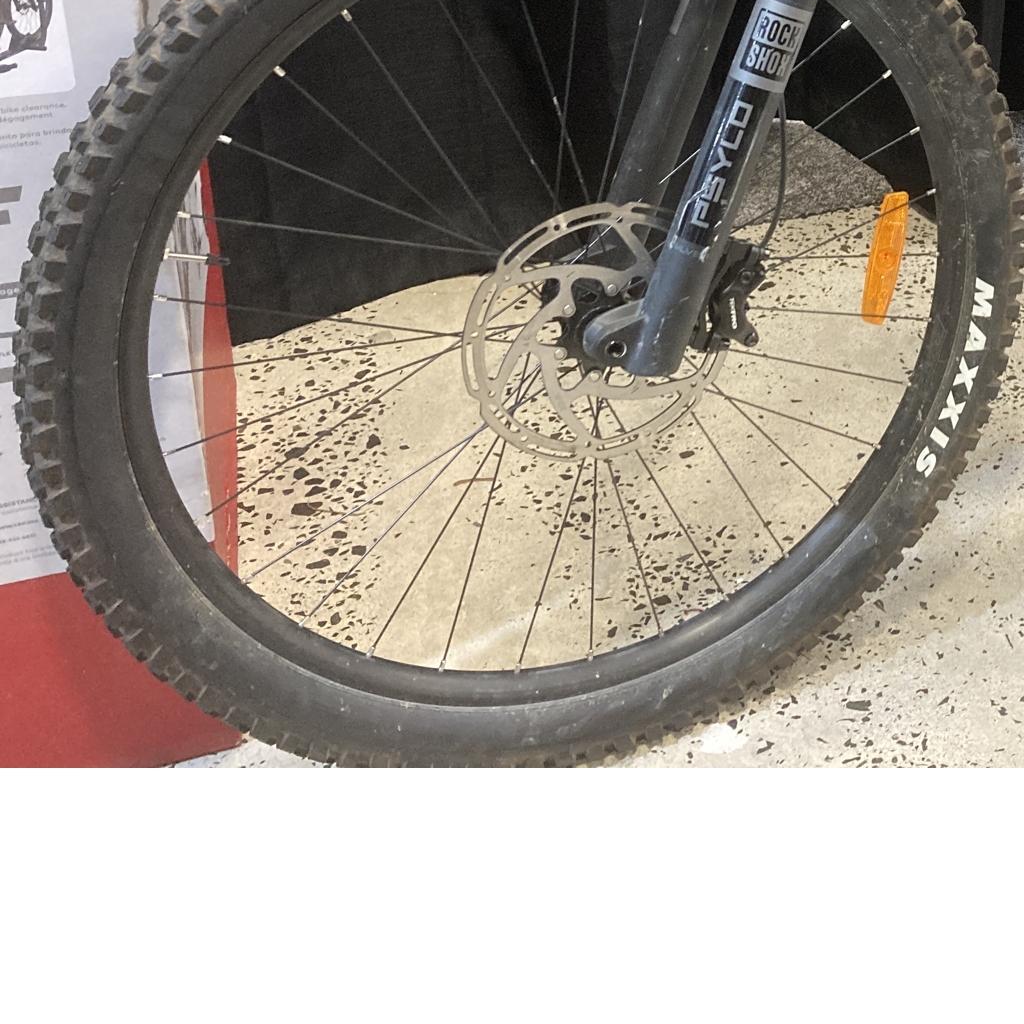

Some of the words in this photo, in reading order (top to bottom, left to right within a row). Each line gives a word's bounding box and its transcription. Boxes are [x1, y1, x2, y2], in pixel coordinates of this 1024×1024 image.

[745, 41, 791, 77] SHOX
[756, 15, 801, 50] ROCK
[691, 98, 754, 229] PSYLO
[916, 276, 996, 478] MAXXIS
